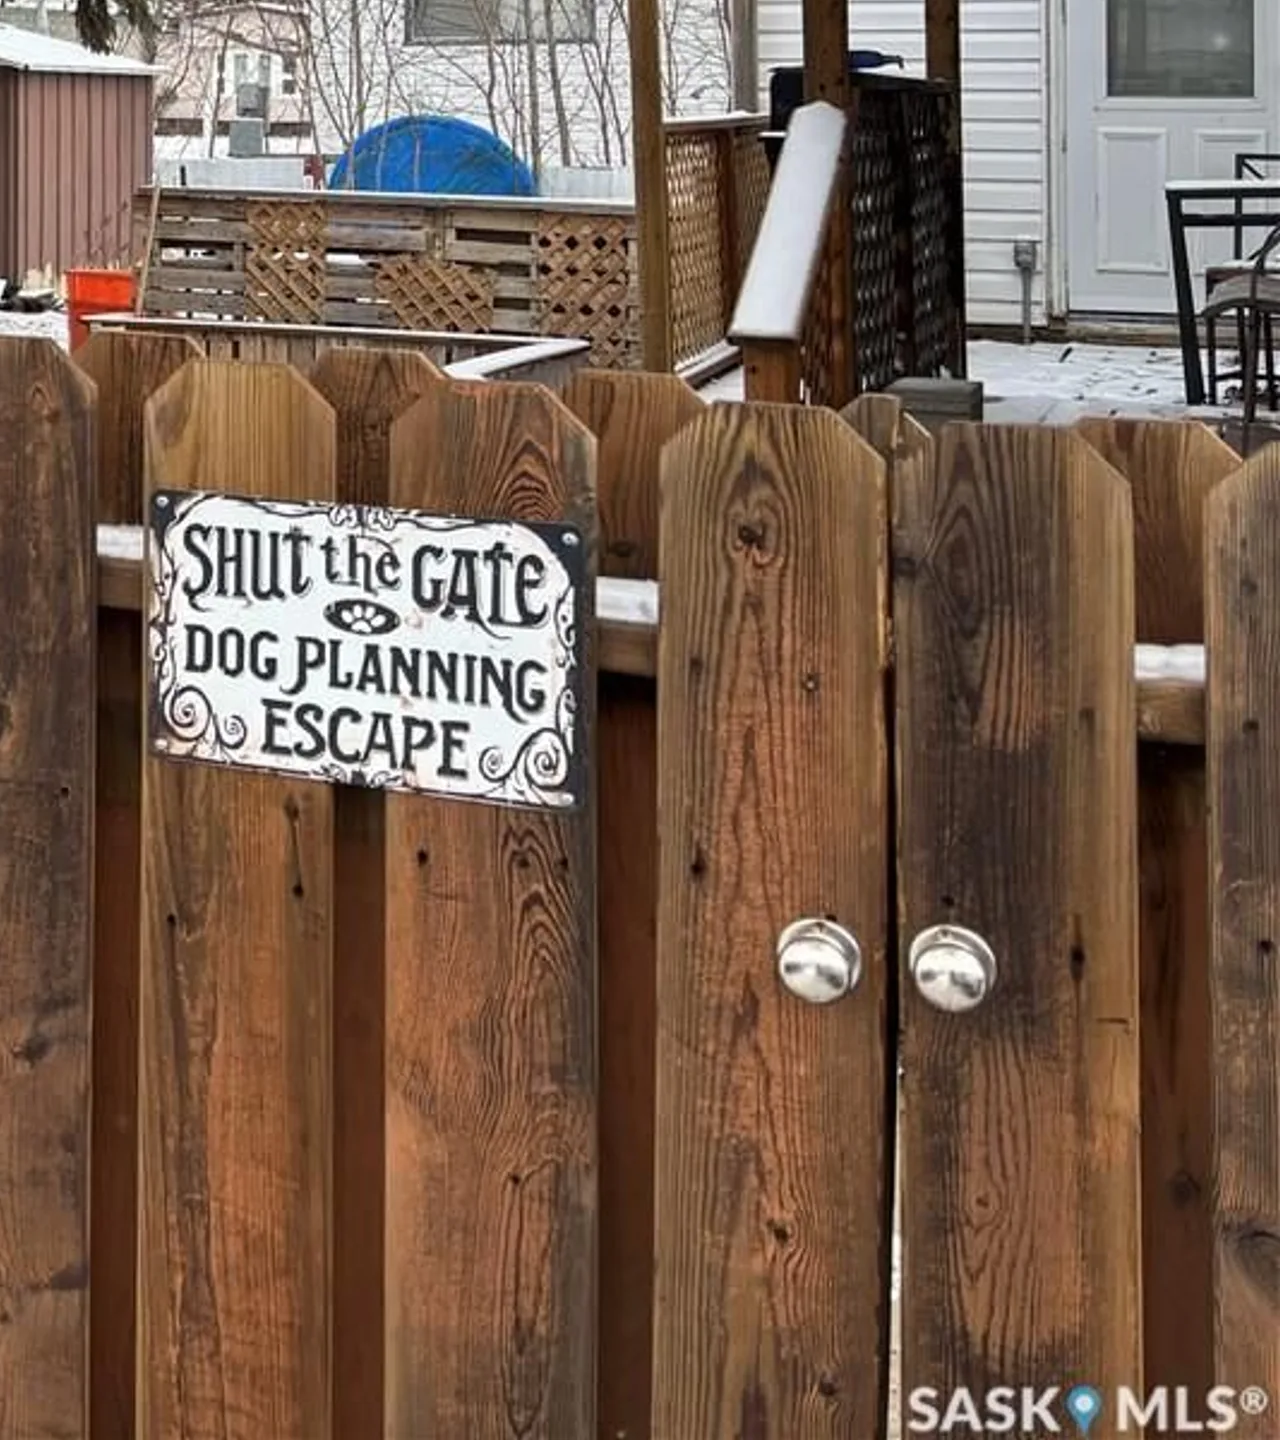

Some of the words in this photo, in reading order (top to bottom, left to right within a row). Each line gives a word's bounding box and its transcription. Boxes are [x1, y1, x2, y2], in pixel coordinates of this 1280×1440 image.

[185, 624, 278, 679] DOG
[280, 635, 547, 723] PLANNING
[260, 698, 470, 778] ESCAPE
